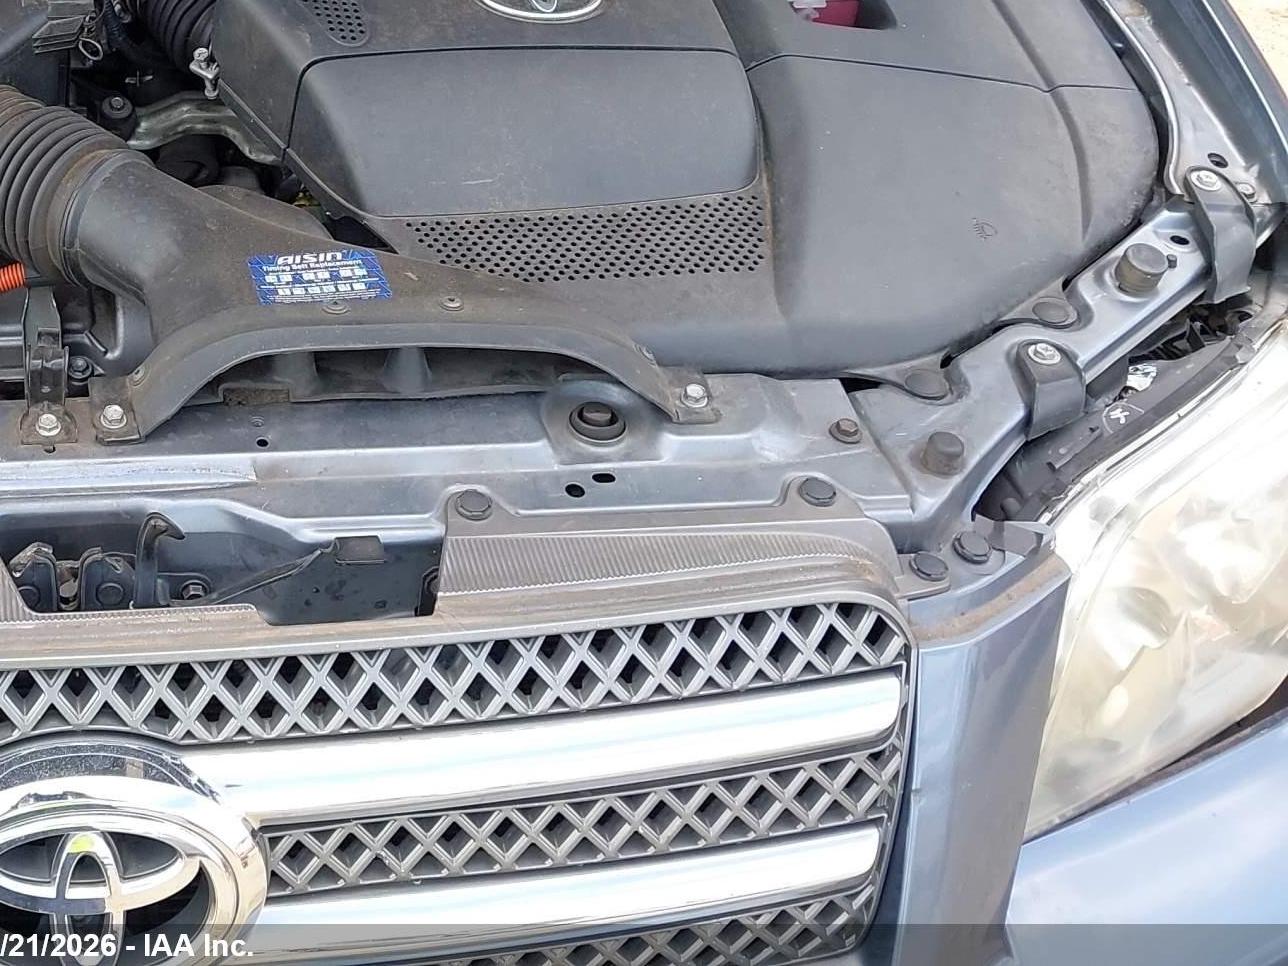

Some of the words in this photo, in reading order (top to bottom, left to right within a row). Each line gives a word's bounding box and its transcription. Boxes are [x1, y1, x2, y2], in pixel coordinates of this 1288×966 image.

[262, 264, 291, 273] Timing
[292, 263, 308, 271] Belt
[309, 259, 363, 269] Replacement
